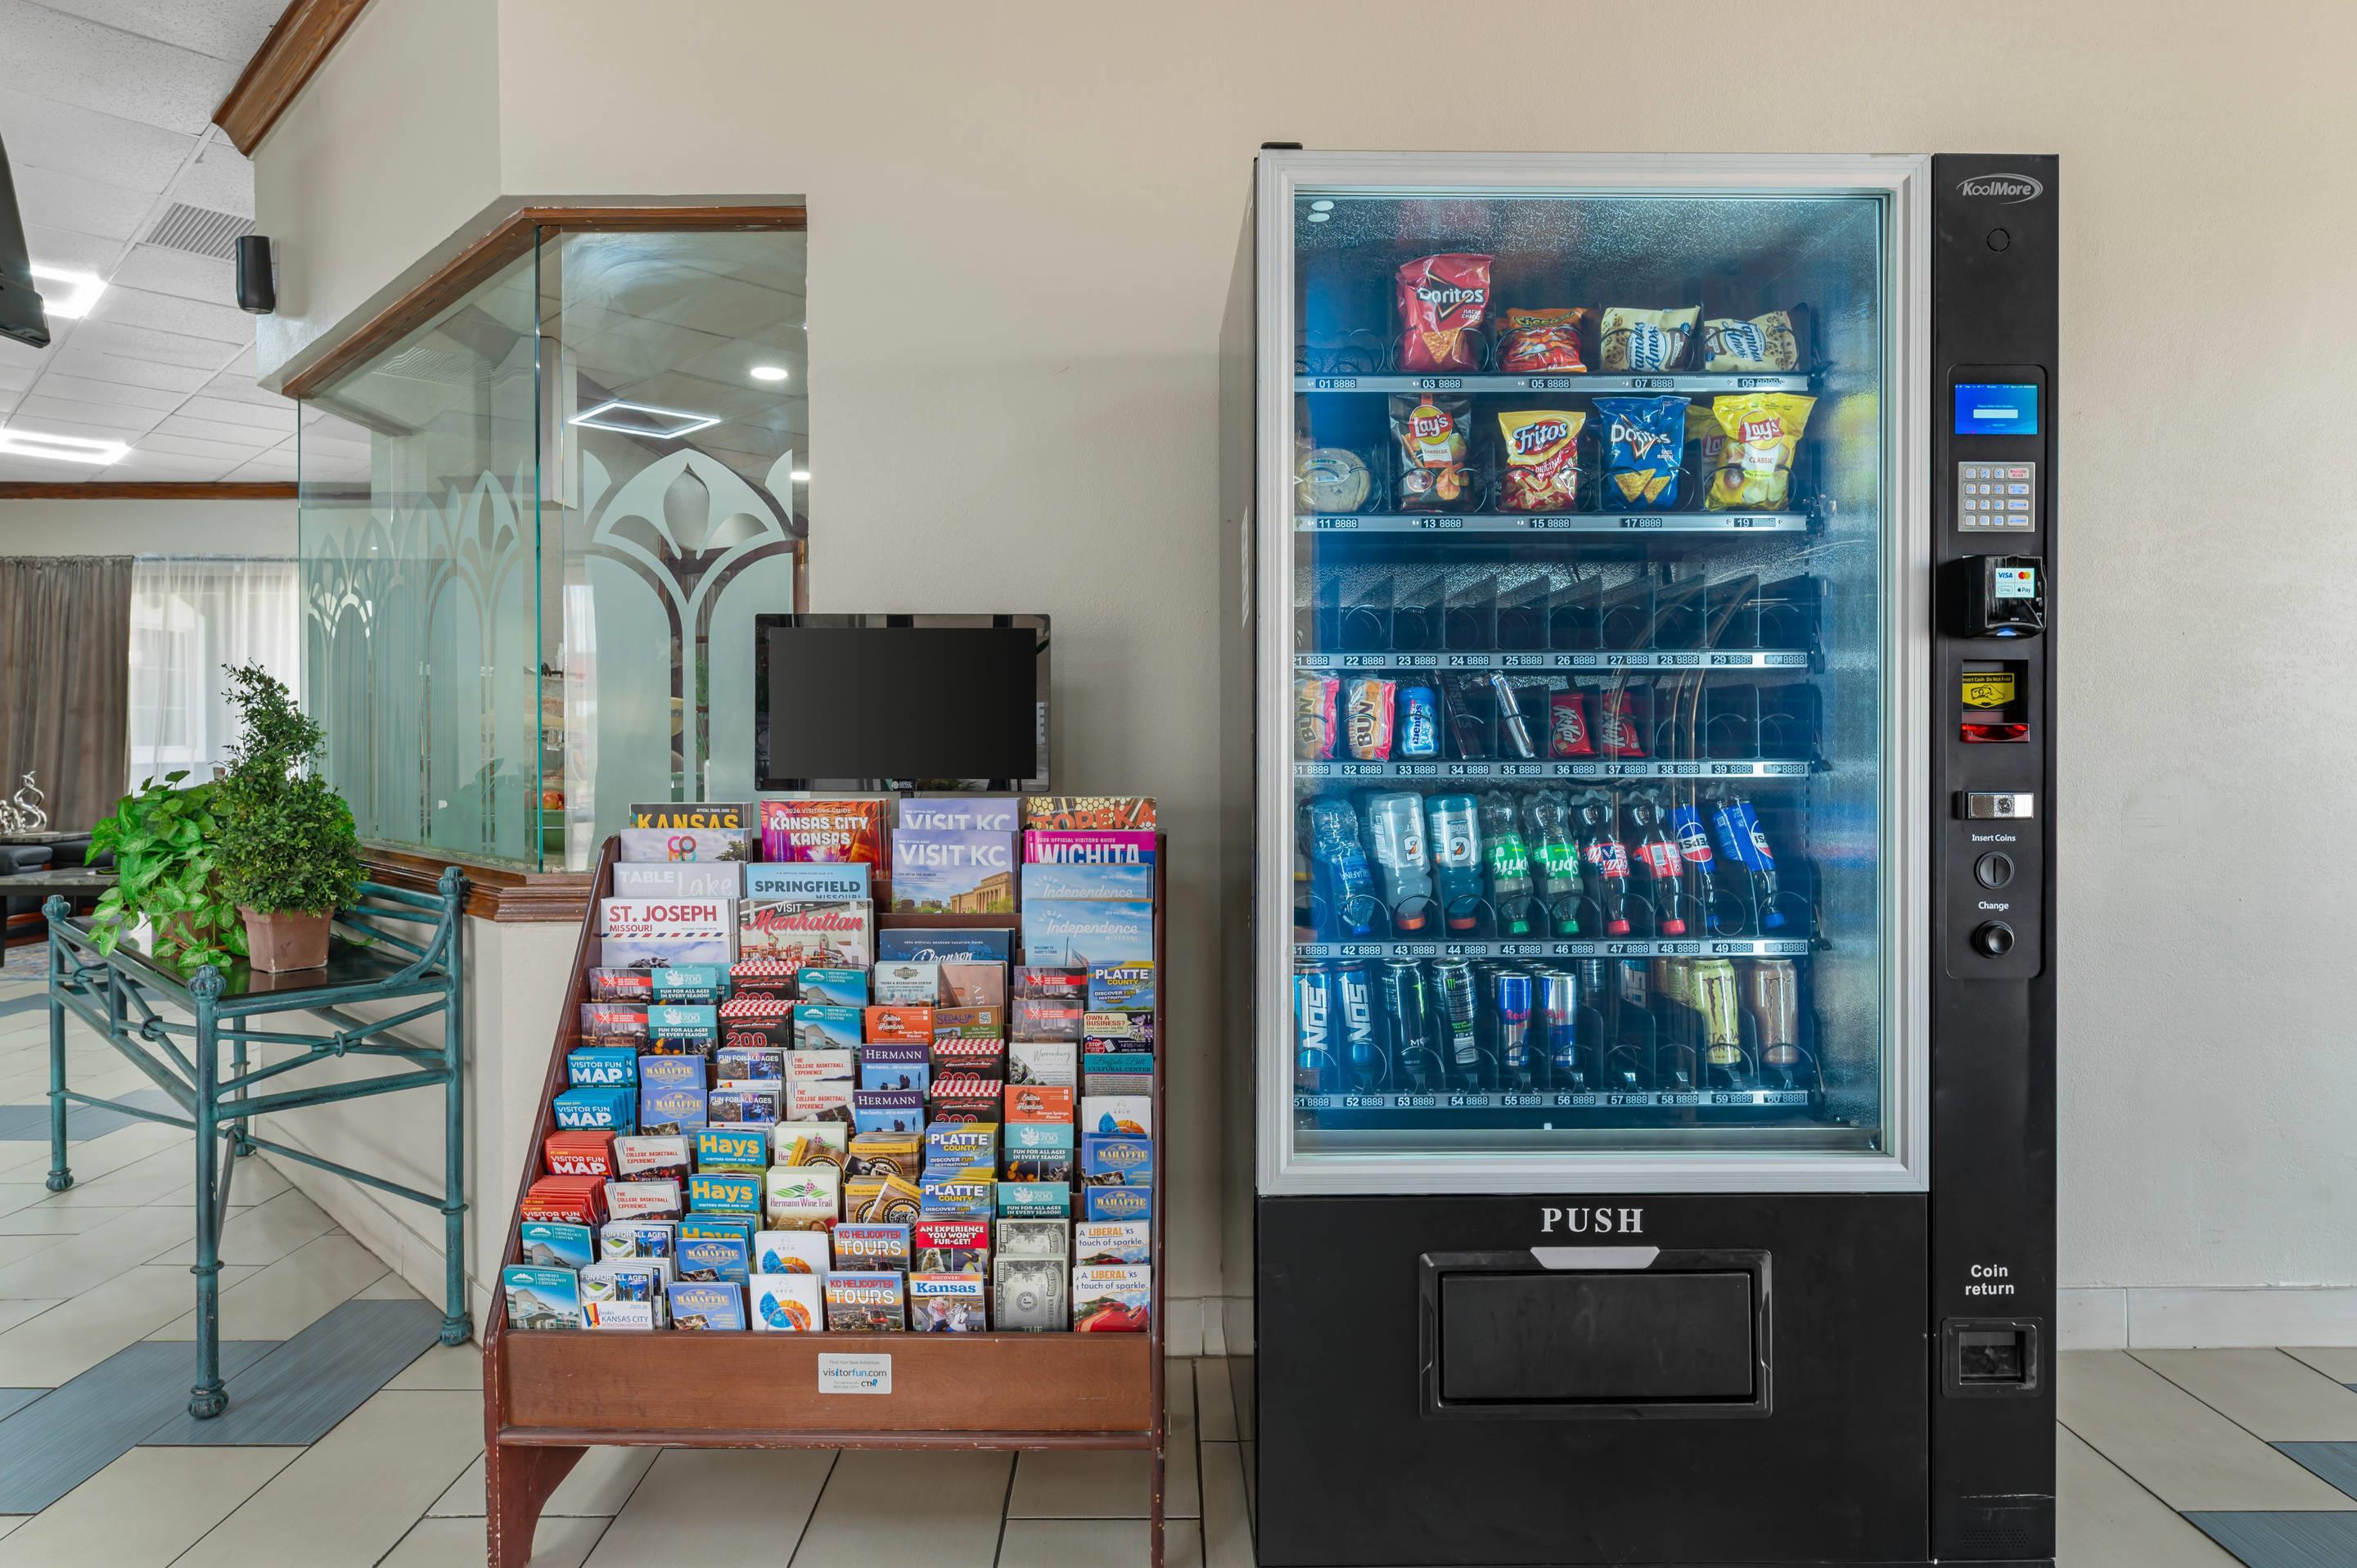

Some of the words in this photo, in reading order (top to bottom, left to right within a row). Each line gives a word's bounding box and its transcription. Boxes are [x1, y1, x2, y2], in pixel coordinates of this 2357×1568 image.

[1963, 182, 2031, 196] KoolMore
[1417, 287, 1485, 304] Doritos
[1645, 325, 1658, 371] Amos
[1319, 380, 1330, 388] 01
[1333, 380, 1355, 388] 8888
[1422, 380, 1435, 388] 03
[1439, 380, 1461, 388] 8888
[1532, 380, 1544, 388] 05
[1547, 380, 1570, 388] 8888
[1652, 379, 1673, 387] 8888
[1742, 379, 1754, 387] 09
[1414, 413, 1451, 438] Lay's
[1744, 417, 1780, 442] Lay's
[1512, 421, 1567, 453] Fritos
[1319, 520, 1331, 528] 11
[1335, 520, 1357, 528] 8888
[1424, 520, 1435, 528] 13
[1440, 520, 1461, 528] 8888
[1639, 519, 1661, 527] 8888
[1300, 697, 1317, 744] BUN
[1357, 701, 1375, 747] BUN
[1413, 704, 1422, 745] mentos
[1399, 766, 1412, 774] 33
[1414, 766, 1436, 774] 8888
[638, 814, 738, 829] KANSAS
[770, 817, 833, 830] KANSAS
[835, 817, 868, 830] CITY
[905, 813, 973, 829] VISIT
[976, 813, 1011, 829] KC
[791, 832, 850, 845] KANSAS
[1972, 834, 1994, 842] Insert
[1995, 834, 2016, 842] Coins
[898, 844, 967, 866] VISIT
[971, 844, 1007, 866] KC
[1039, 844, 1139, 863] WICHITA
[619, 871, 674, 883] TABLE
[678, 871, 732, 897] Lake
[755, 881, 860, 893] SPRINGFIELD
[1043, 884, 1133, 898] Independence
[775, 903, 802, 913] VISIT
[1978, 902, 2009, 911] Change
[609, 905, 638, 922] ST.
[642, 905, 717, 922] JOSEPH
[742, 909, 864, 932] Manhattan
[609, 924, 653, 932] MISSOURI
[1047, 919, 1138, 938] Independence
[1556, 945, 1568, 953] 46
[1096, 969, 1148, 979] PLATTE
[1303, 987, 1328, 1050] NOS
[1348, 984, 1372, 1042] NOS
[1506, 1009, 1526, 1020] Red
[726, 1032, 767, 1048] 200
[866, 1050, 922, 1060] HERMANN
[572, 1069, 623, 1084] MAP
[859, 1096, 916, 1105] HERMANN
[1558, 1097, 1571, 1105] 56
[558, 1112, 612, 1126] MAP
[700, 1134, 760, 1156] Hays
[931, 1133, 988, 1146] PLATTE
[552, 1161, 607, 1174] MAP
[692, 1181, 753, 1203] Hays
[926, 1185, 984, 1196] PLATTE
[770, 1198, 800, 1207] Hermann
[800, 1198, 818, 1207] Wine
[818, 1199, 832, 1207] Trail
[1541, 1208, 1643, 1233] PUSH
[839, 1231, 850, 1239] KC
[852, 1231, 901, 1239] HELICOPTER
[1088, 1227, 1124, 1237] LIBERAL
[839, 1240, 904, 1255] TOURS
[1113, 1238, 1145, 1247] sparkle.
[1971, 1264, 2008, 1277] Coin
[830, 1280, 842, 1288] KC
[844, 1280, 895, 1288] HELICOPTER
[916, 1282, 976, 1293] Kansas
[1965, 1282, 2015, 1295] return
[831, 1289, 895, 1304] TOURS
[822, 1368, 887, 1377] visitorfun.com
